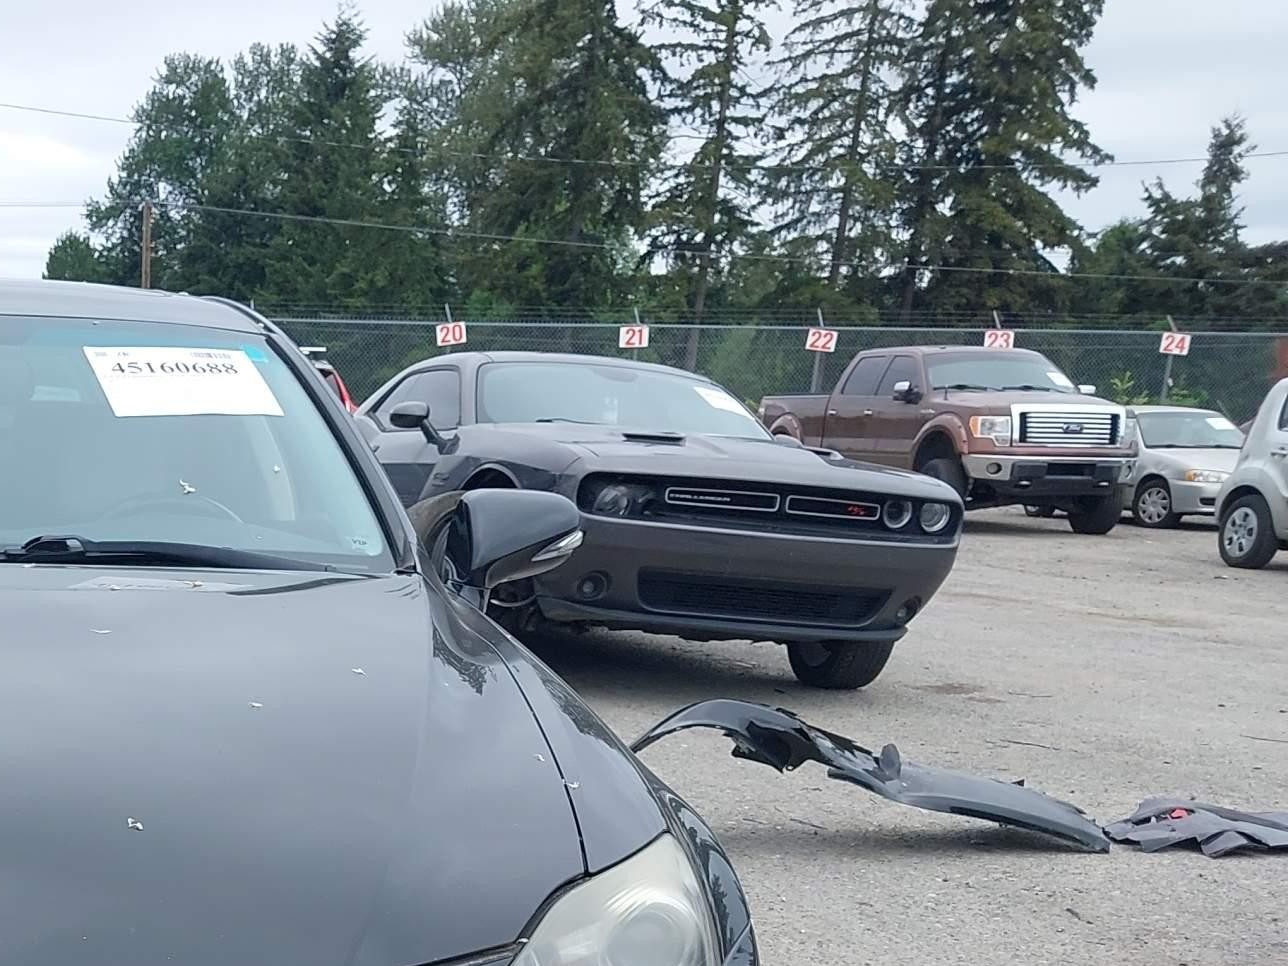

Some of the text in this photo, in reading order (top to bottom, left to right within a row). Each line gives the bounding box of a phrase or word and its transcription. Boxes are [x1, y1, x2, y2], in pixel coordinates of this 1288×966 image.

[439, 326, 463, 343] 20
[625, 328, 643, 346] 21
[809, 331, 834, 350] 22
[987, 332, 1011, 348] 23
[1163, 335, 1186, 353] 24
[111, 361, 239, 375] 45160688
